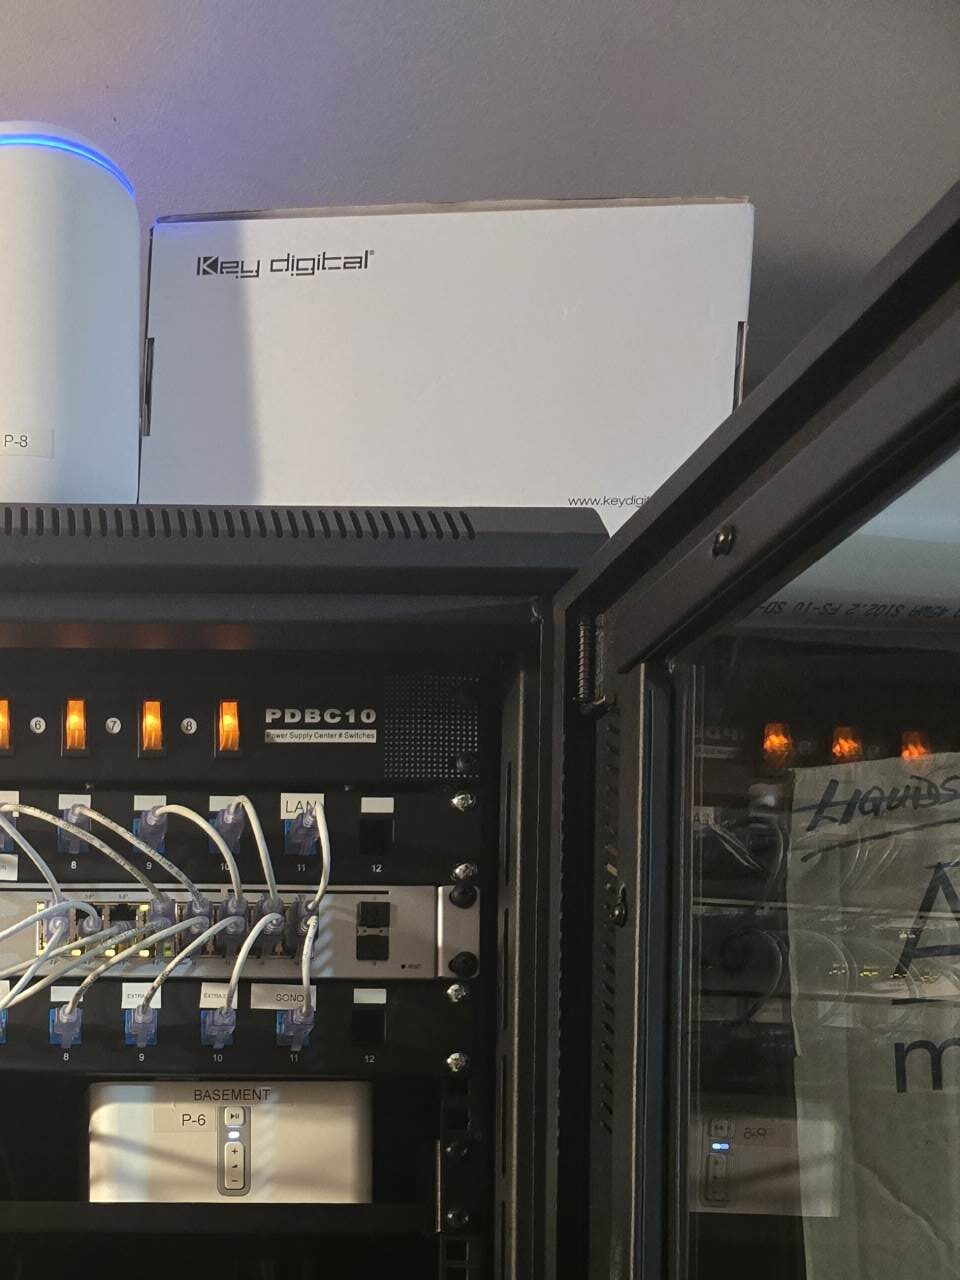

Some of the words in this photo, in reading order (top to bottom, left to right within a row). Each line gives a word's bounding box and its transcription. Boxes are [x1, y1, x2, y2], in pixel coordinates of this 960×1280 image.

[196, 256, 261, 278] Key
[270, 250, 369, 276] digital
[4, 434, 28, 448] P-8
[265, 708, 377, 723] PDBC10
[33, 719, 43, 731] 6
[108, 719, 119, 732] 7
[184, 719, 194, 733] 8
[266, 731, 288, 739] Power
[289, 731, 313, 740] Supply
[314, 731, 337, 739] Center
[344, 731, 375, 739] Switches
[70, 861, 77, 869] 8
[146, 862, 152, 870] 9
[298, 863, 306, 871] 11
[371, 864, 382, 873] 12
[63, 1053, 69, 1062] 8
[138, 1053, 145, 1062] 9
[213, 1054, 223, 1062] 10
[290, 1054, 298, 1062] 11
[364, 1055, 375, 1063] 12
[194, 1089, 272, 1101] BASEMENT
[182, 1113, 206, 1126] P-6
